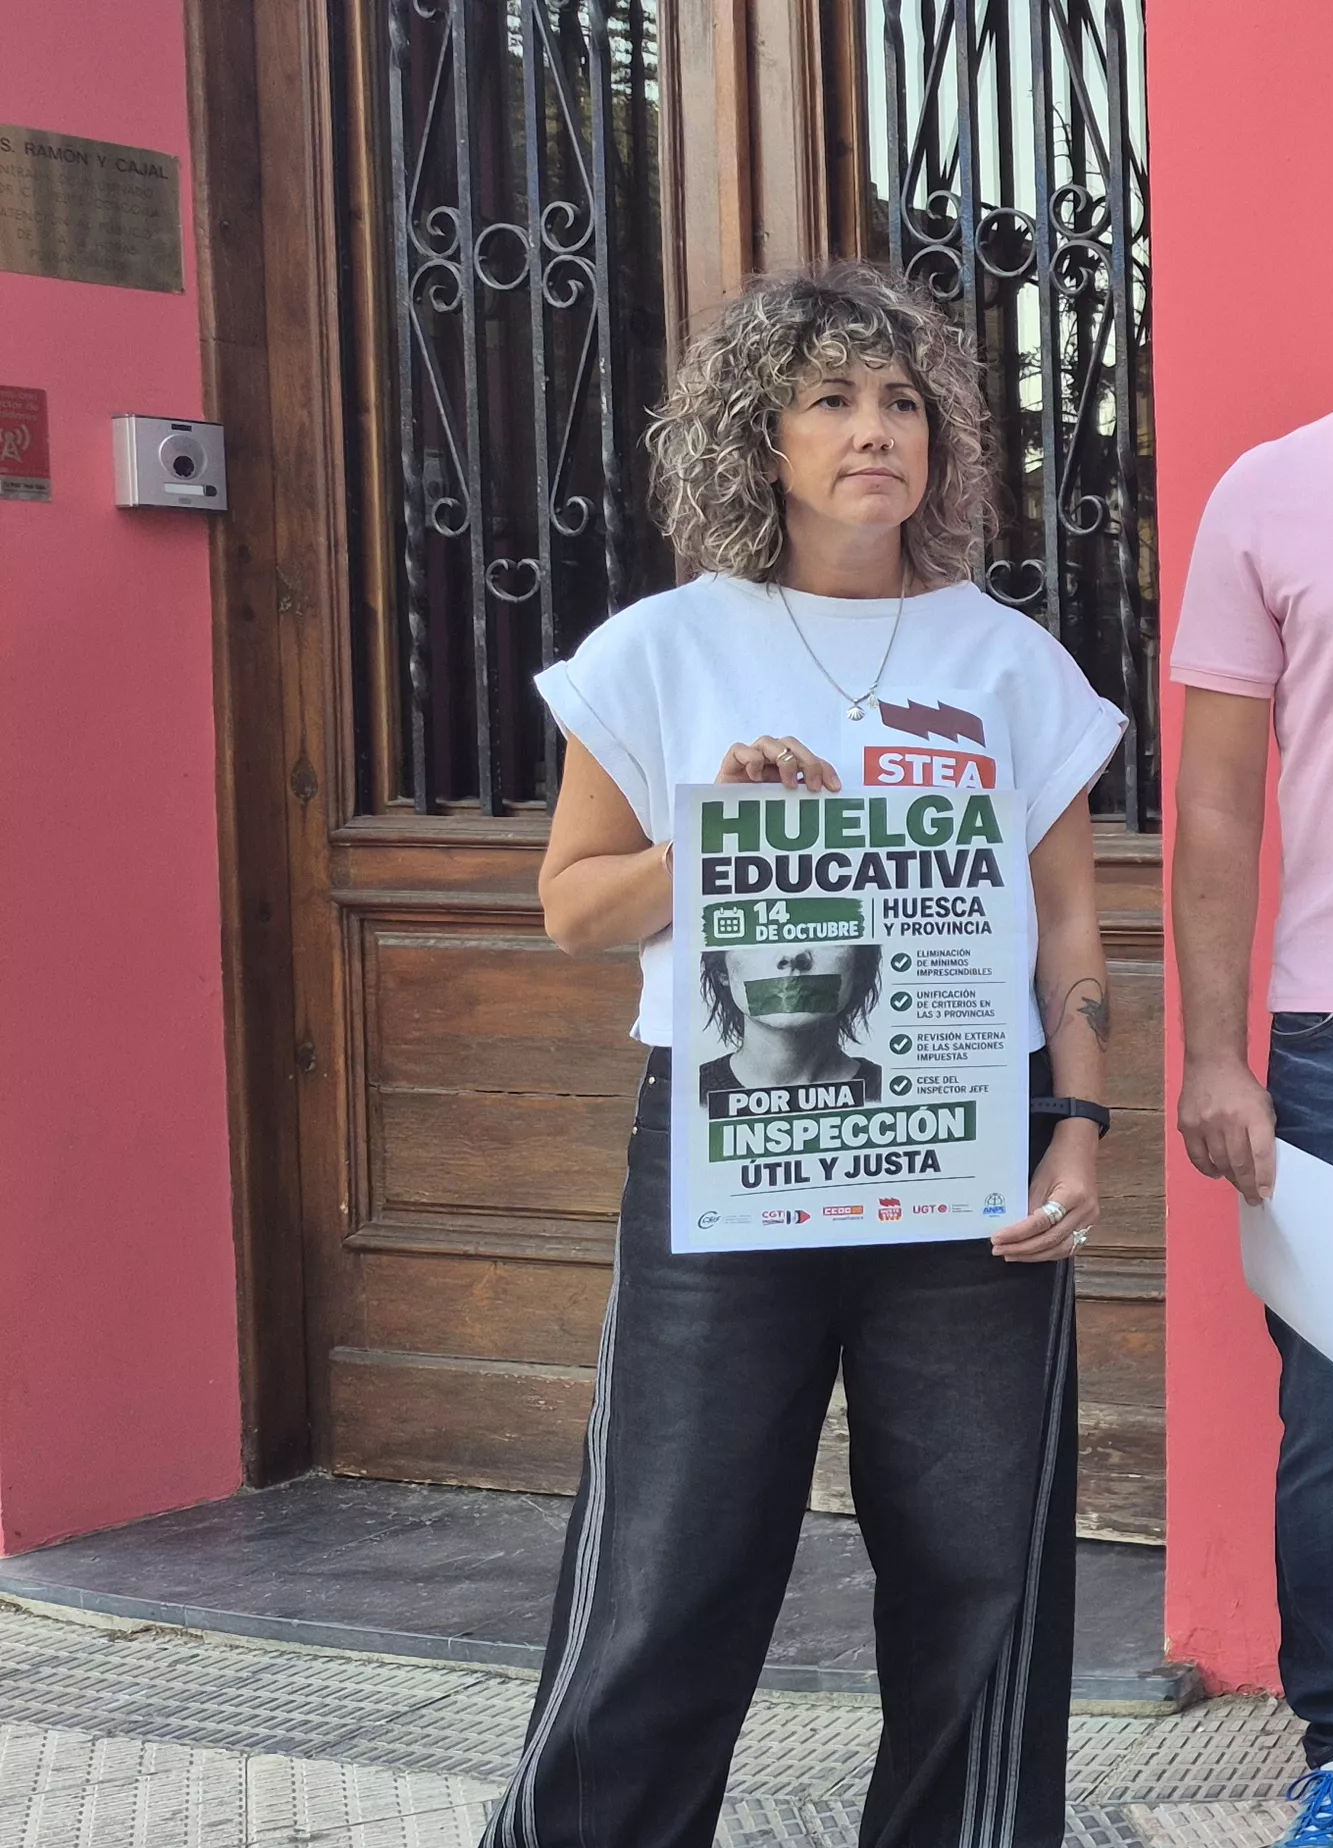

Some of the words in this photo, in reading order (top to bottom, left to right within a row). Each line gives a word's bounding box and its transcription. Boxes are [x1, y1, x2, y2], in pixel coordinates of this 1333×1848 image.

[96, 155, 107, 168] Y
[115, 158, 169, 180] CAJAL
[877, 752, 984, 788] STEA
[701, 795, 1004, 853] HUELGA
[702, 848, 1005, 895] EDUCATIVA
[753, 901, 790, 923] 14
[883, 896, 986, 919] HUESCA
[756, 925, 779, 941] DE
[782, 920, 859, 940] OCTUBRE
[884, 922, 895, 937] Y
[900, 920, 993, 936] PROVINCIA
[916, 948, 971, 958] ELIMINACIÓN
[916, 959, 928, 967] DE
[916, 967, 993, 977] IMPRESCINDIBLES
[916, 989, 976, 999] UNIFICACIÓN
[916, 1000, 929, 1009] DE
[931, 1000, 978, 1009] CRITERIOS
[980, 999, 991, 1008] EN
[916, 1010, 933, 1018] LAS
[936, 1010, 941, 1018] 3
[944, 1009, 995, 1018] PROVINCIAS
[917, 1032, 962, 1042] REVISIÓN
[964, 1031, 1006, 1040] EXTERNA
[917, 1043, 929, 1052] DE
[932, 1043, 950, 1052] LAS
[952, 1041, 1004, 1051] SANCIONES
[917, 1052, 969, 1061] IMPUESTAS
[917, 1076, 940, 1085] CESE
[942, 1076, 960, 1084] DEL
[917, 1085, 967, 1095] INSPECTOR
[968, 1084, 989, 1094] JEFE
[728, 1091, 791, 1116] POR
[798, 1085, 855, 1110] UNA
[722, 1106, 965, 1157] INSPECCIÓN
[741, 1159, 811, 1189] ÚTIL
[819, 1156, 839, 1181] Y
[844, 1149, 941, 1179] JUSTA
[912, 1204, 936, 1214] UGT
